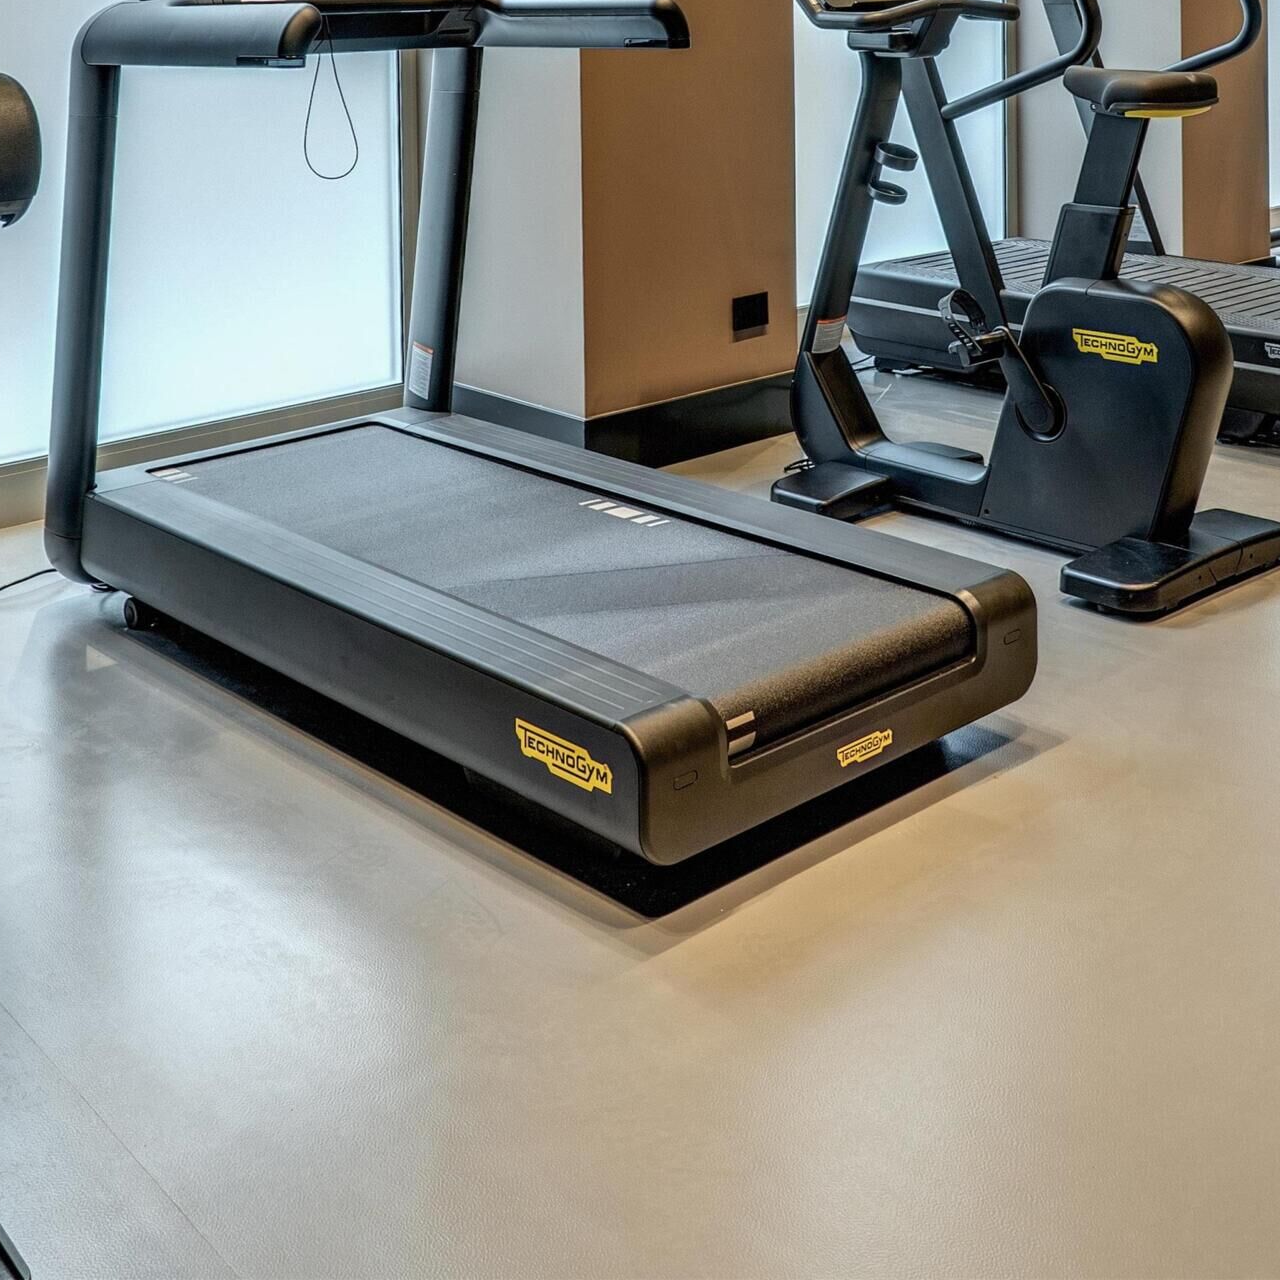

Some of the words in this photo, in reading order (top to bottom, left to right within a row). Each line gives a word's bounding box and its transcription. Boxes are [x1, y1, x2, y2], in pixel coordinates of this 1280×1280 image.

[1074, 332, 1154, 359] TECHNOGYM
[518, 724, 608, 785] TECHNOGYM
[838, 732, 890, 763] TECHNOGYM
